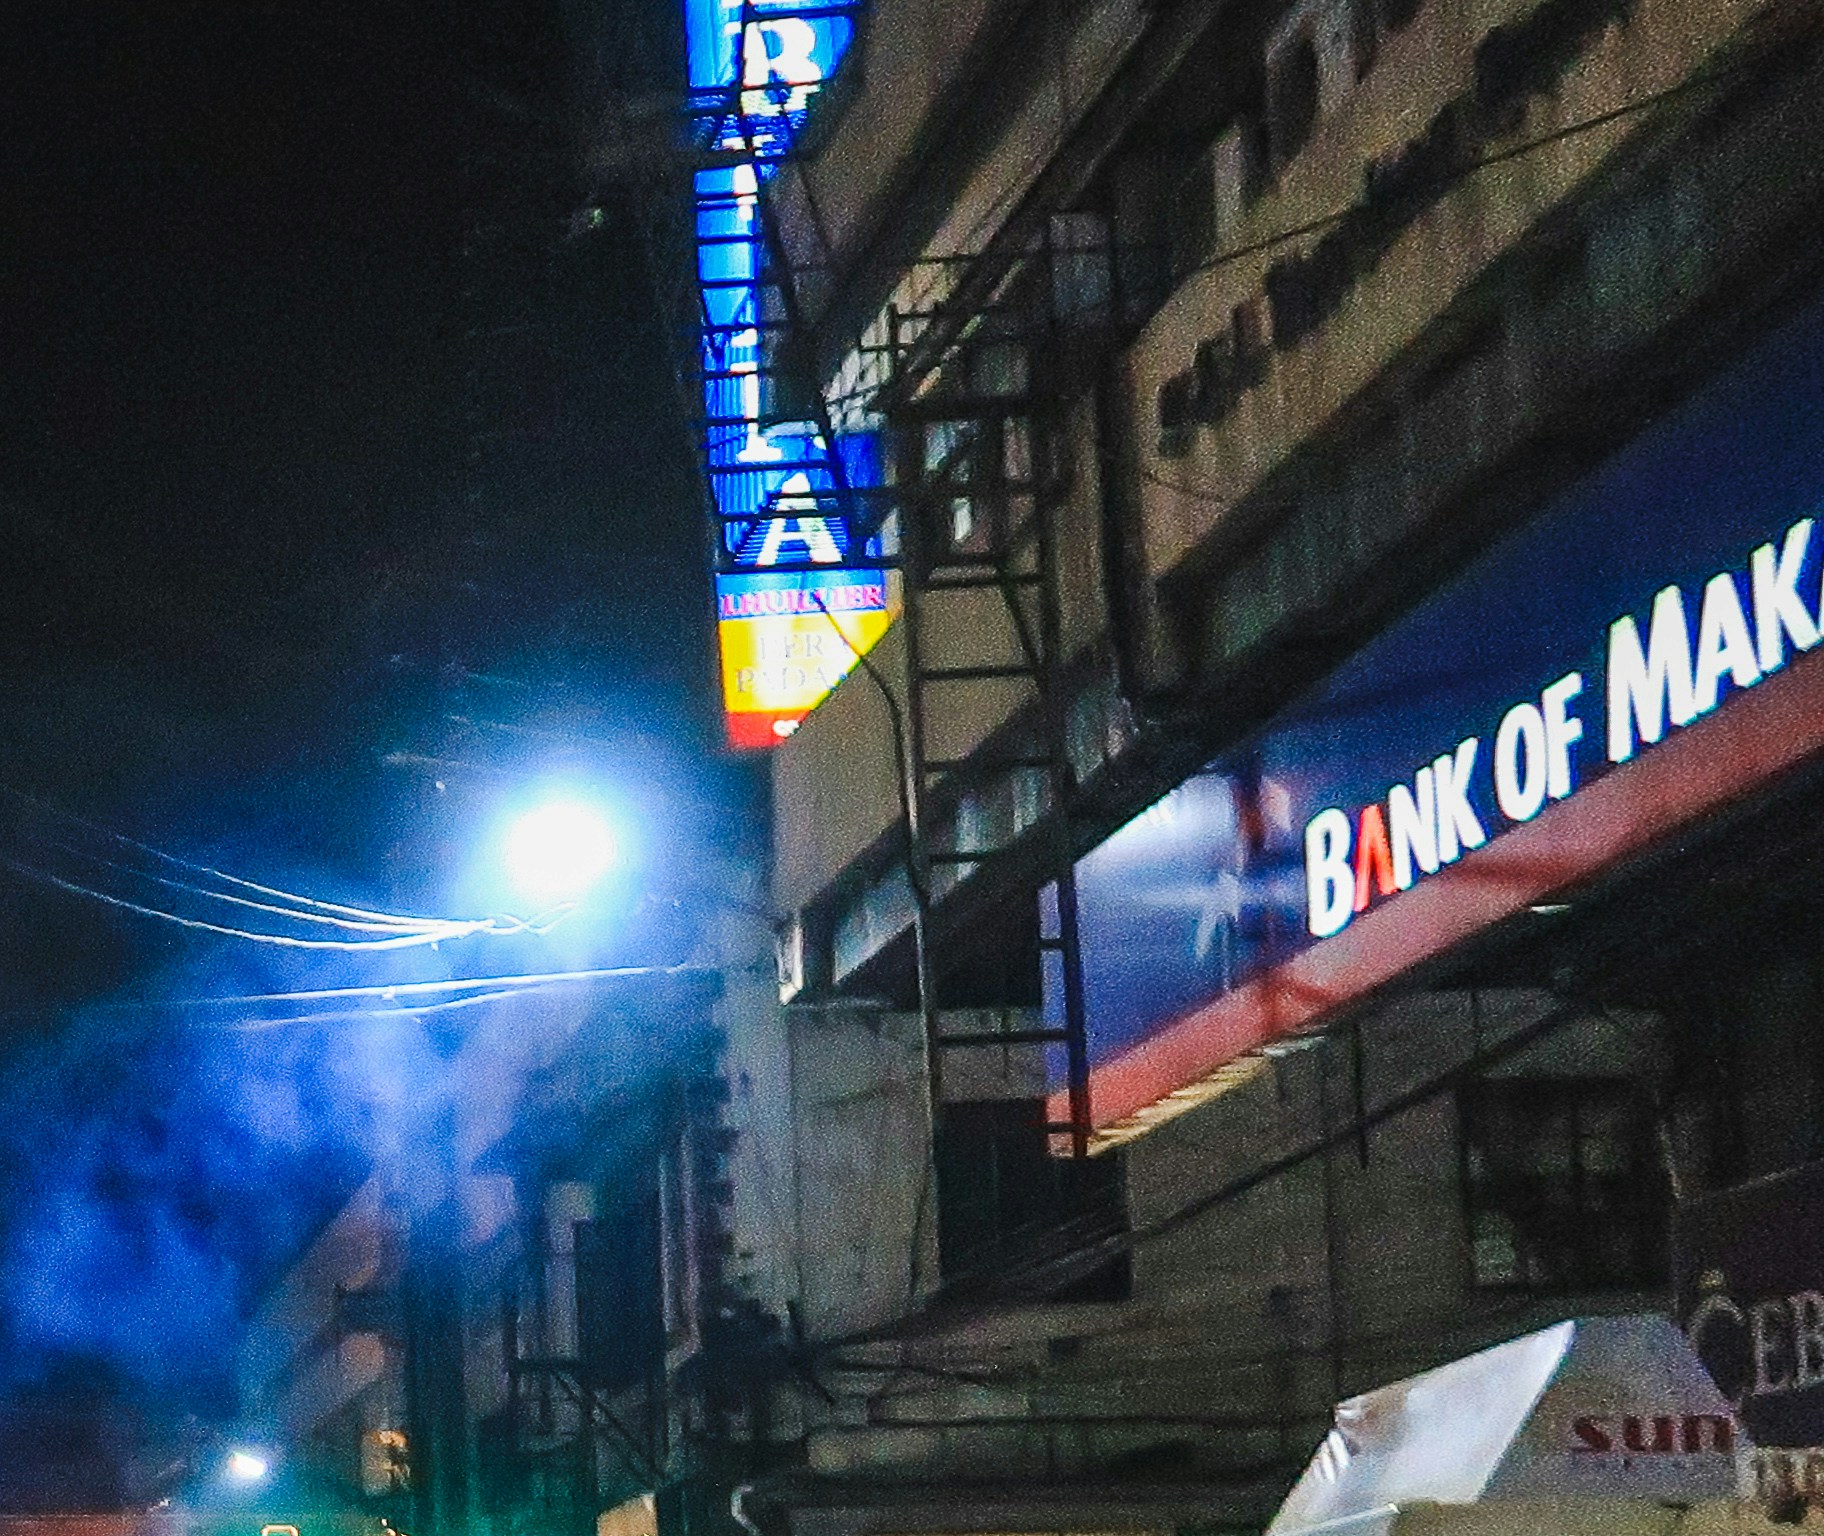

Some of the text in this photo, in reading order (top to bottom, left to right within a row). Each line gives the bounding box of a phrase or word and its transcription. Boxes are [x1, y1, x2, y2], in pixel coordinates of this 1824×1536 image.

[1305, 516, 1824, 938] BANK OF MAK
